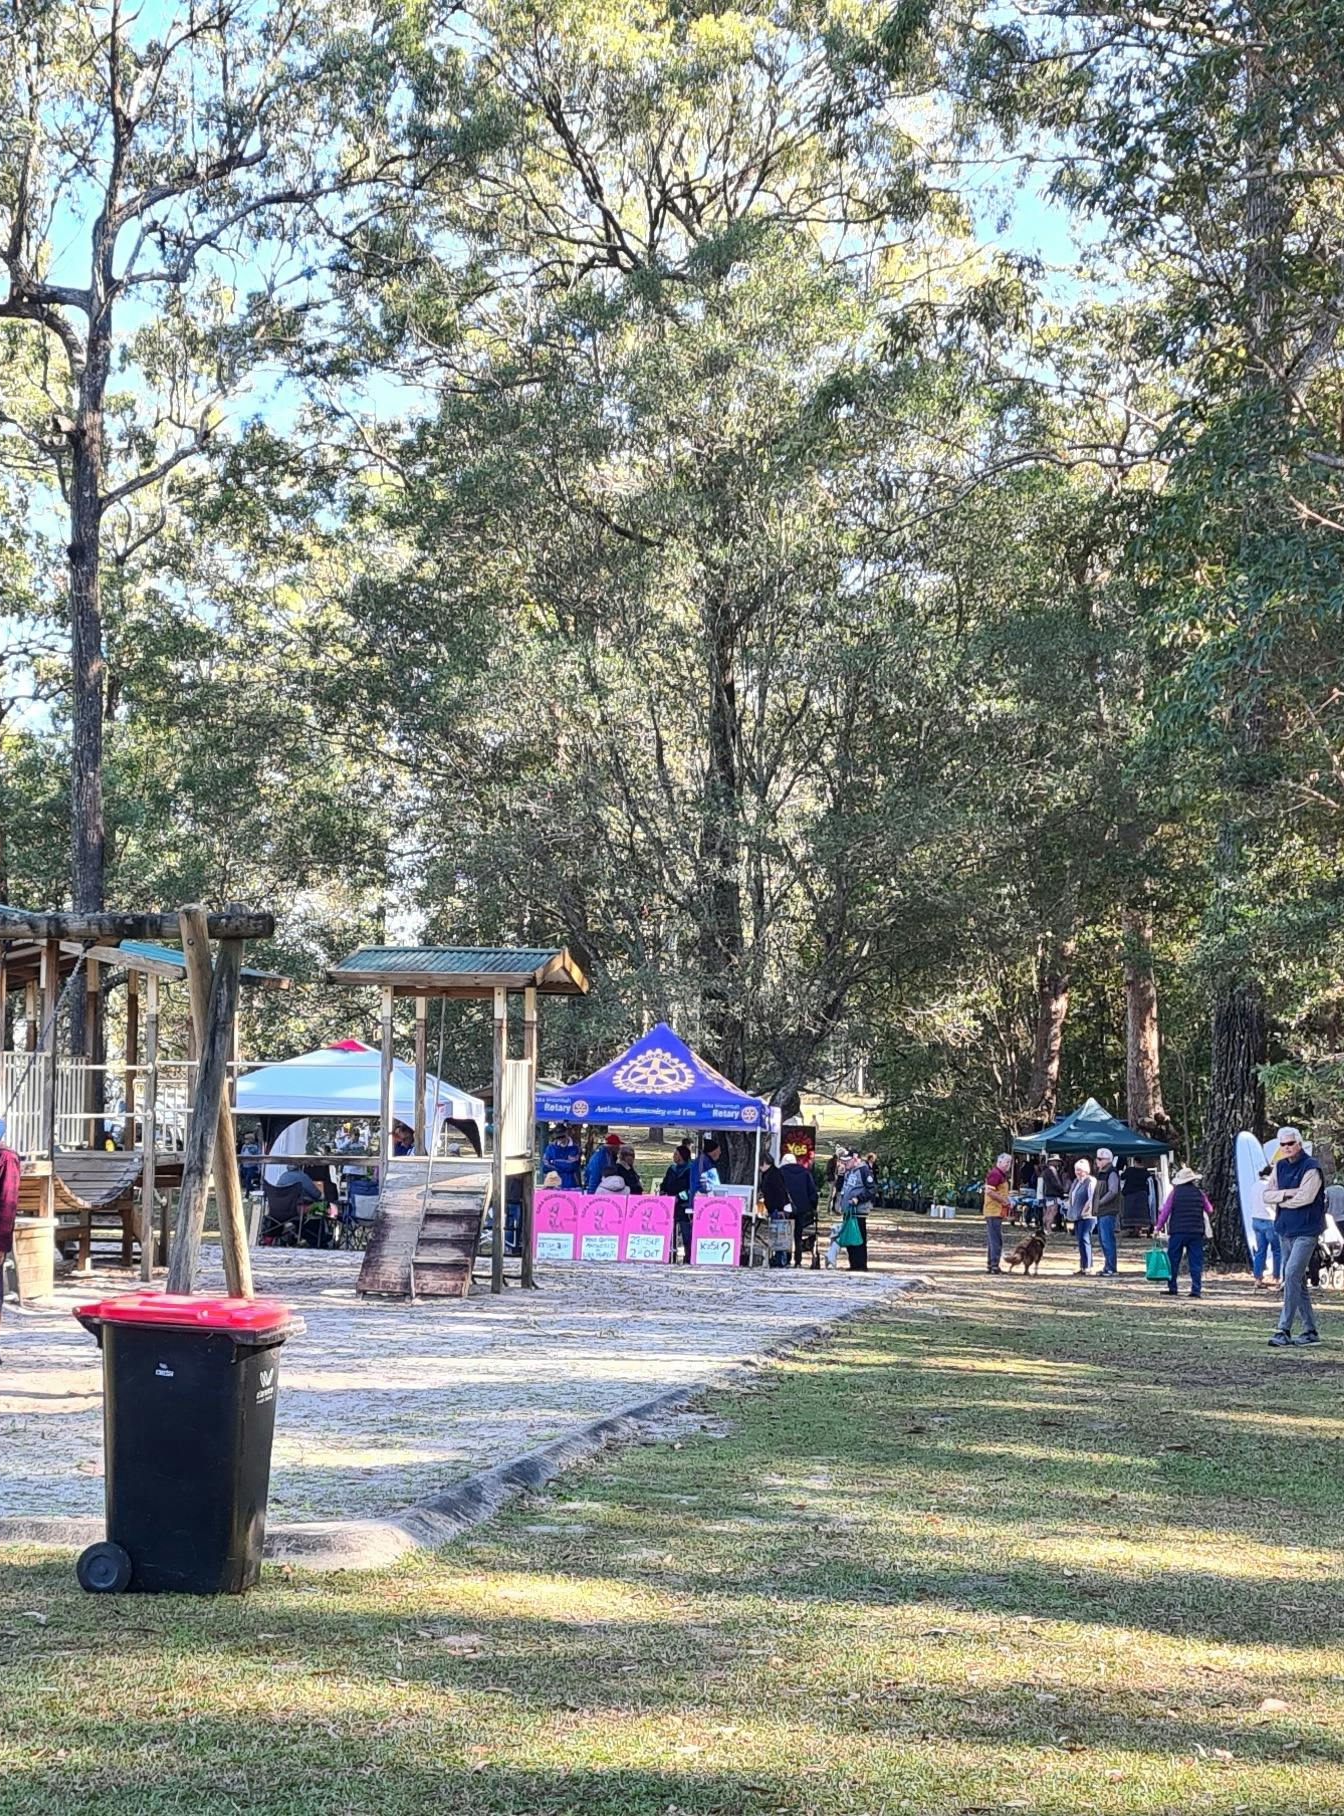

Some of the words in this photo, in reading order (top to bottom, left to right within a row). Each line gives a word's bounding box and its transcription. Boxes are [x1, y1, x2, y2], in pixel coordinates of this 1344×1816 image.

[544, 1103, 571, 1115] Rotary
[712, 1109, 740, 1120] Rotary
[787, 1143, 807, 1156] Yes
